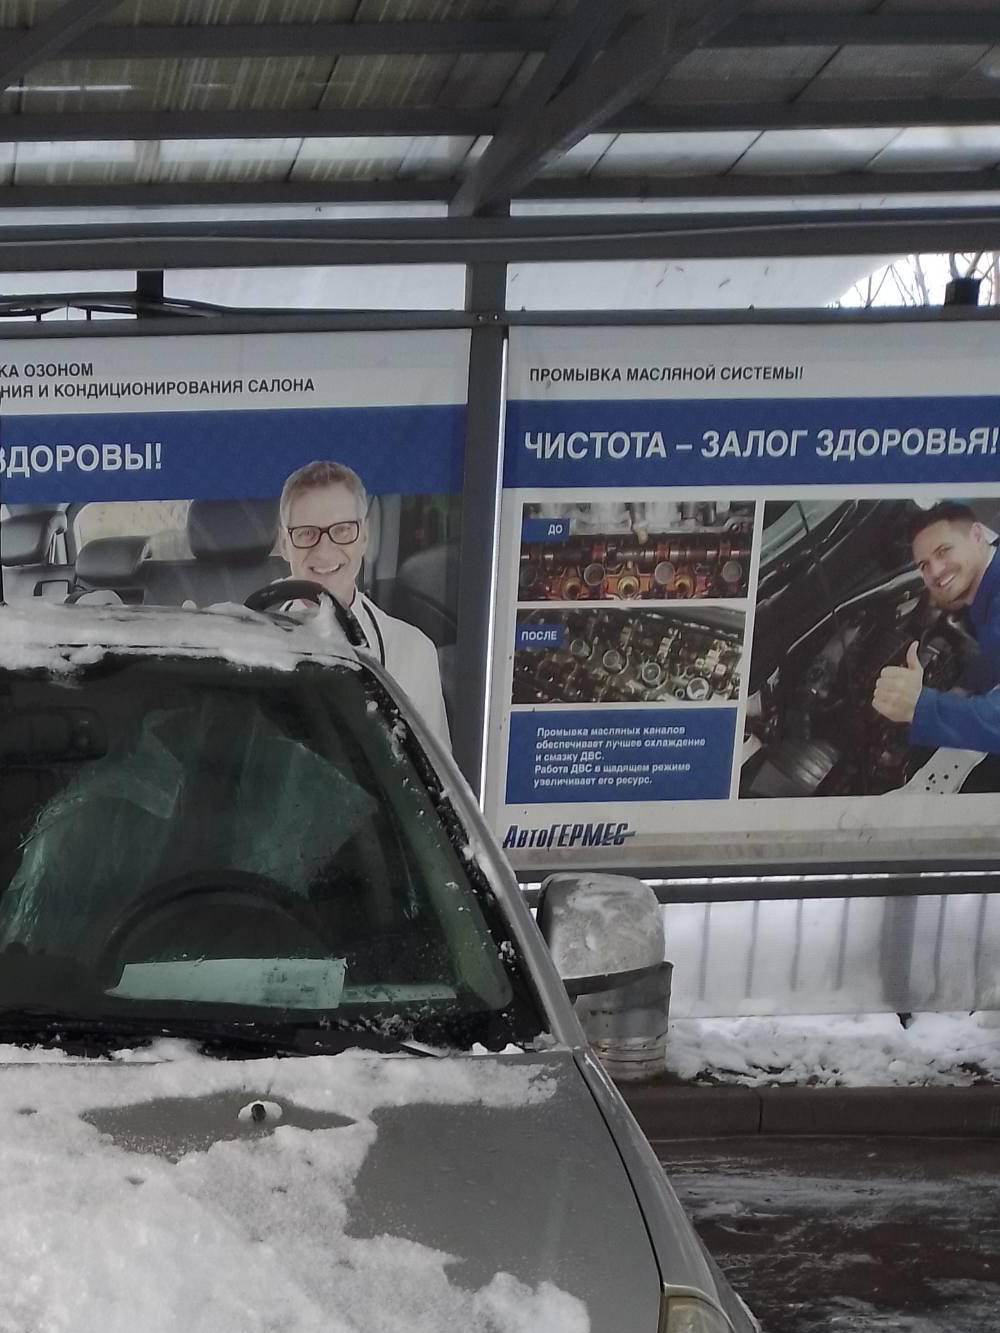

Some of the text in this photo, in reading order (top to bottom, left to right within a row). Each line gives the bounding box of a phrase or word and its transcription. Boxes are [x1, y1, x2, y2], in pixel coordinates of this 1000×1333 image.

[24, 362, 94, 378] ОЗОНОМ
[529, 364, 804, 382] ПРОМЫВКА МАСЛЯНОЙ СИСТЕМЫ!
[38, 384, 49, 398] И
[54, 380, 243, 399] КОНДИЦИОНИРОВАНИЯ
[247, 378, 315, 393] САЛОНА
[524, 431, 668, 460] ЧИСТОТА
[700, 429, 809, 458] ЗАЛОГ
[815, 426, 1000, 462] ЗДОРОВЬЯ!
[547, 524, 563, 536] ДО
[521, 630, 558, 641] ПОСЛЕ
[536, 726, 686, 739] Промывка масляных каналов
[536, 738, 706, 750] обеспечивает лучшее охлаждение
[535, 751, 605, 763] и смазку ДВС.
[534, 764, 568, 774] Работа
[570, 763, 592, 775] ДВС
[603, 764, 650, 774] щадящем
[652, 763, 691, 774] режиме
[533, 775, 653, 788] увеличивает его ресурс.
